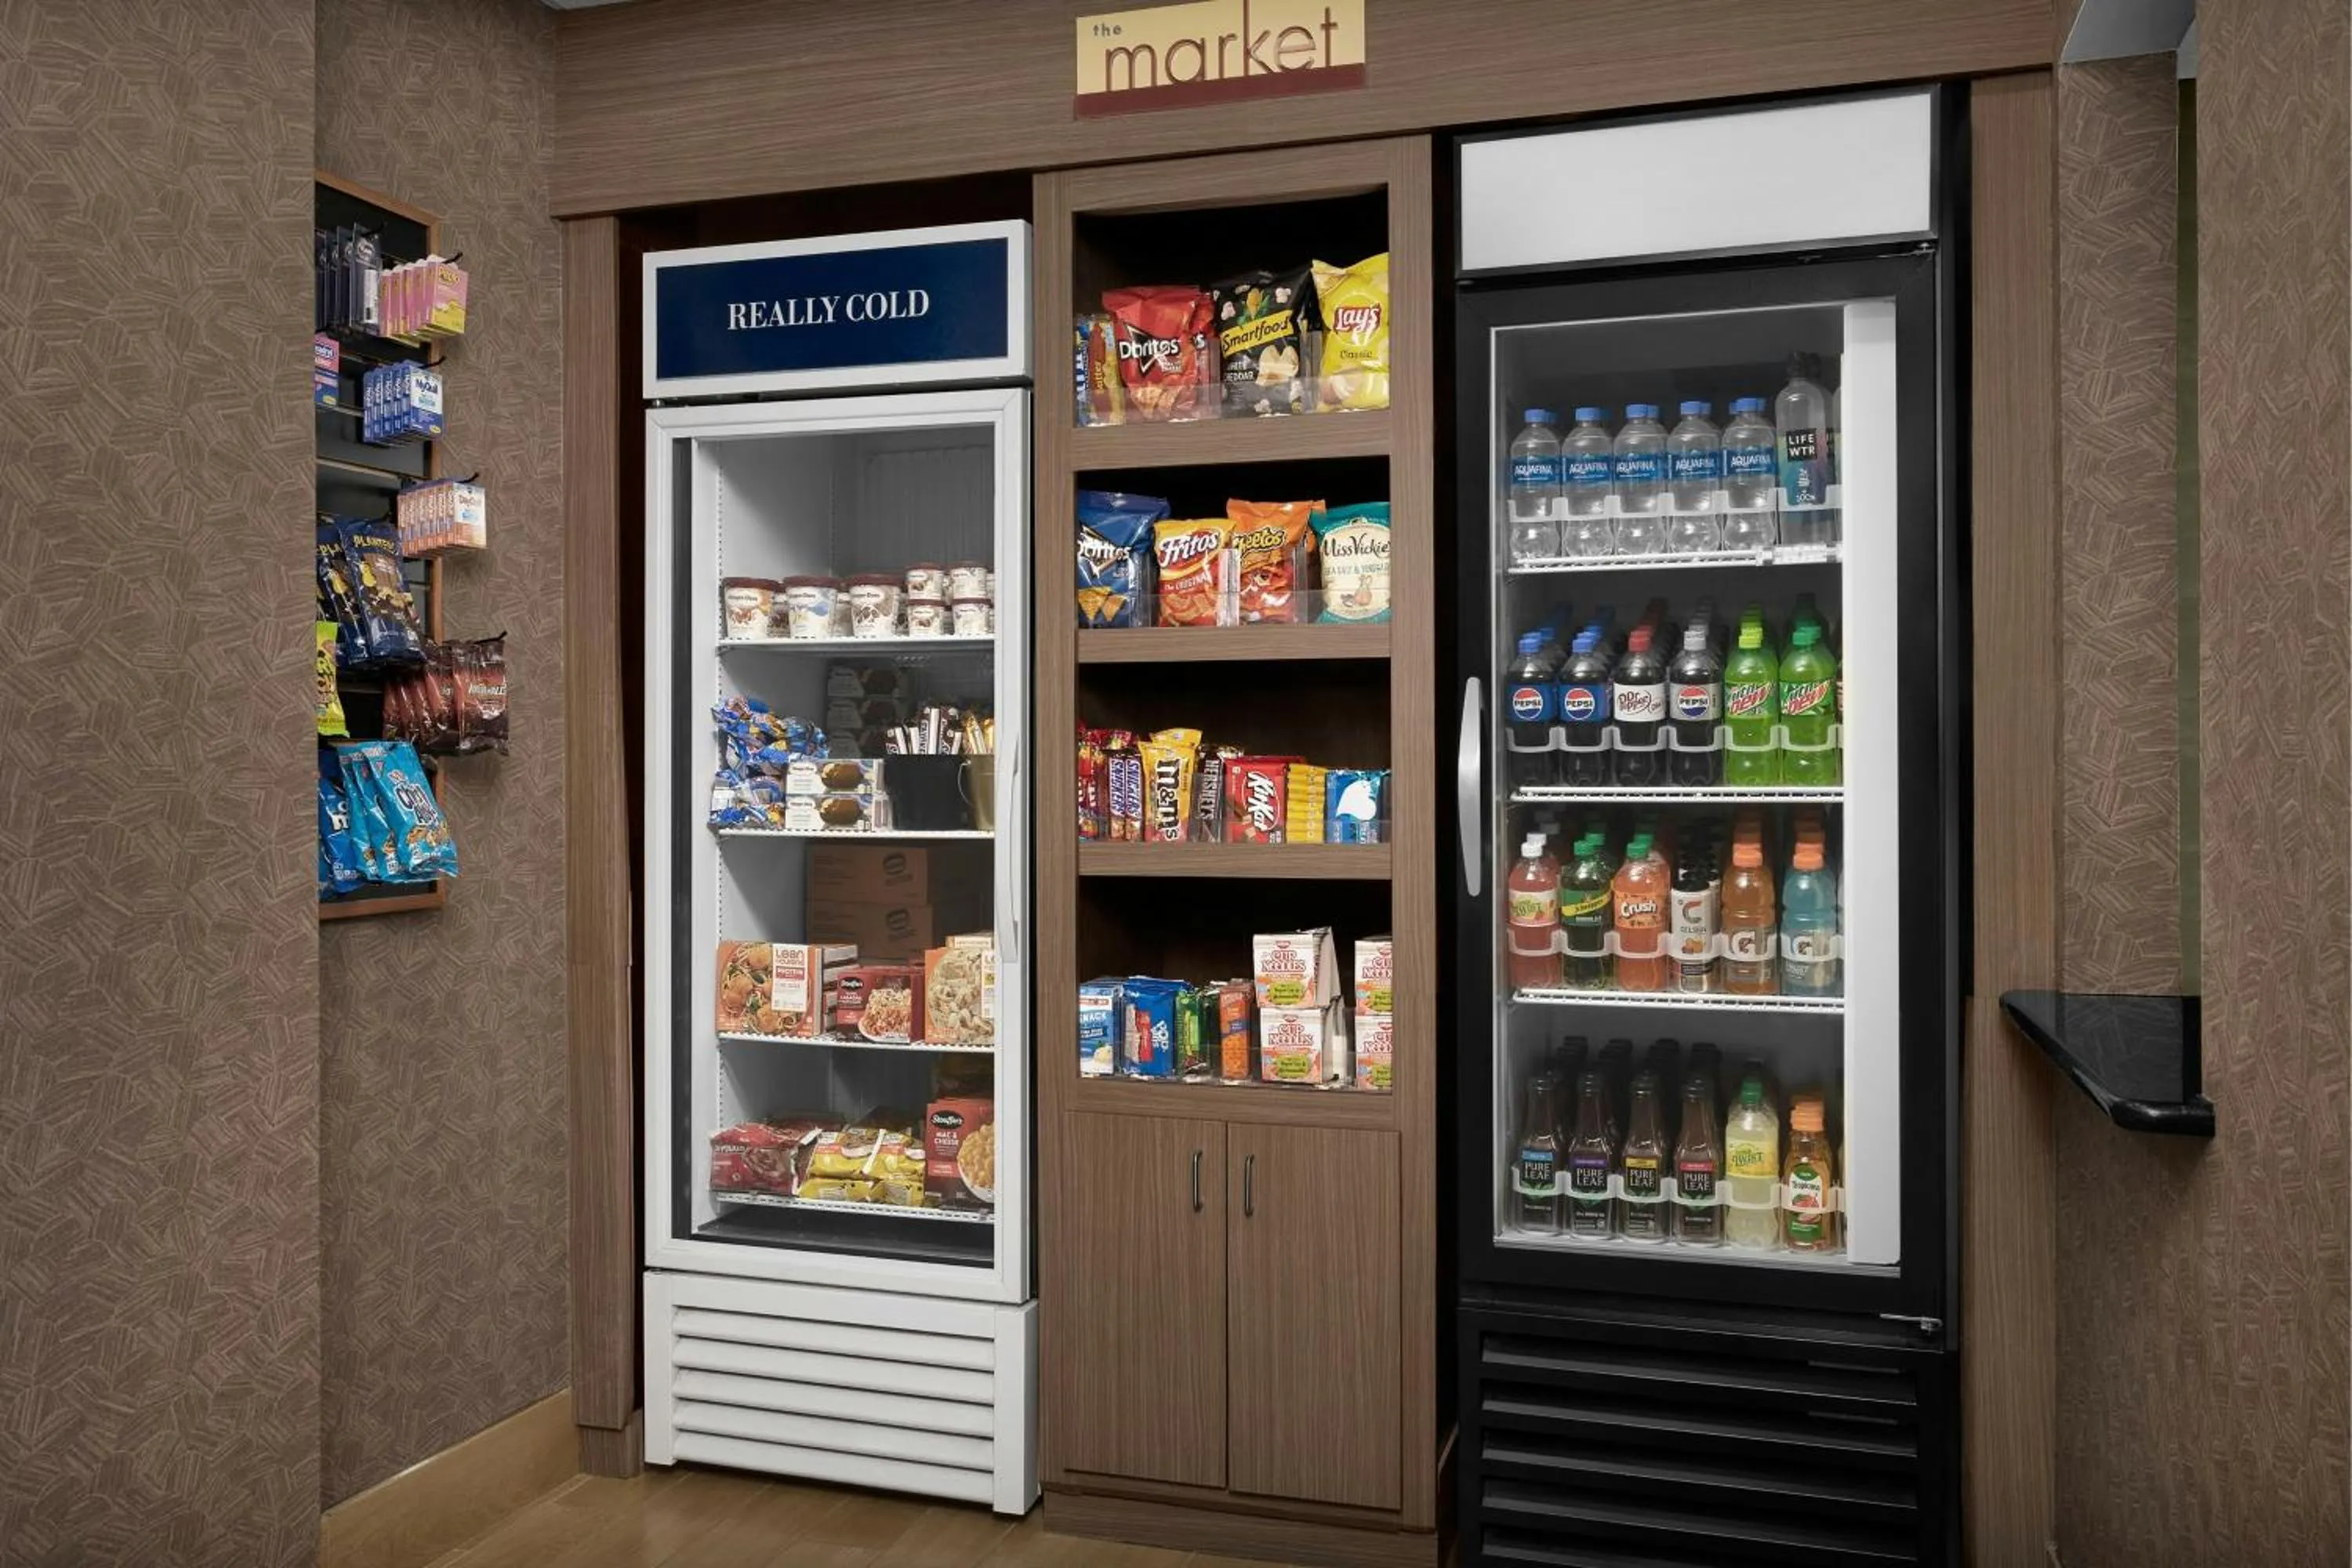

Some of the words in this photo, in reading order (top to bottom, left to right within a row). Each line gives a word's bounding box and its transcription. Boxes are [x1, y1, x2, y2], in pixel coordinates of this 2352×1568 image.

[1092, 24, 1123, 37] the
[1105, 0, 1338, 92] market
[728, 296, 840, 330] REALLY
[846, 289, 930, 322] COLD
[1222, 316, 1290, 353] Smartfood
[1119, 339, 1179, 360] Doritos
[1788, 434, 1814, 444] LIFE
[1788, 445, 1816, 457] WTR
[1160, 532, 1218, 568] Fritos
[1110, 760, 1124, 815] SNICKERS
[1621, 900, 1657, 917] Crush
[1272, 950, 1298, 960] CUP
[1261, 959, 1307, 973] NOODLES
[1279, 1024, 1305, 1033] CUP
[1268, 1033, 1314, 1046] NOODLES
[1525, 1162, 1550, 1171] PURE
[1525, 1171, 1551, 1180] LEAF
[1577, 1168, 1604, 1177] PURE
[1631, 1169, 1654, 1178] PURE
[1683, 1173, 1710, 1181] PURE
[1577, 1178, 1604, 1186] LEAF
[1631, 1178, 1654, 1187] LEAF
[1684, 1181, 1711, 1191] LEAF
